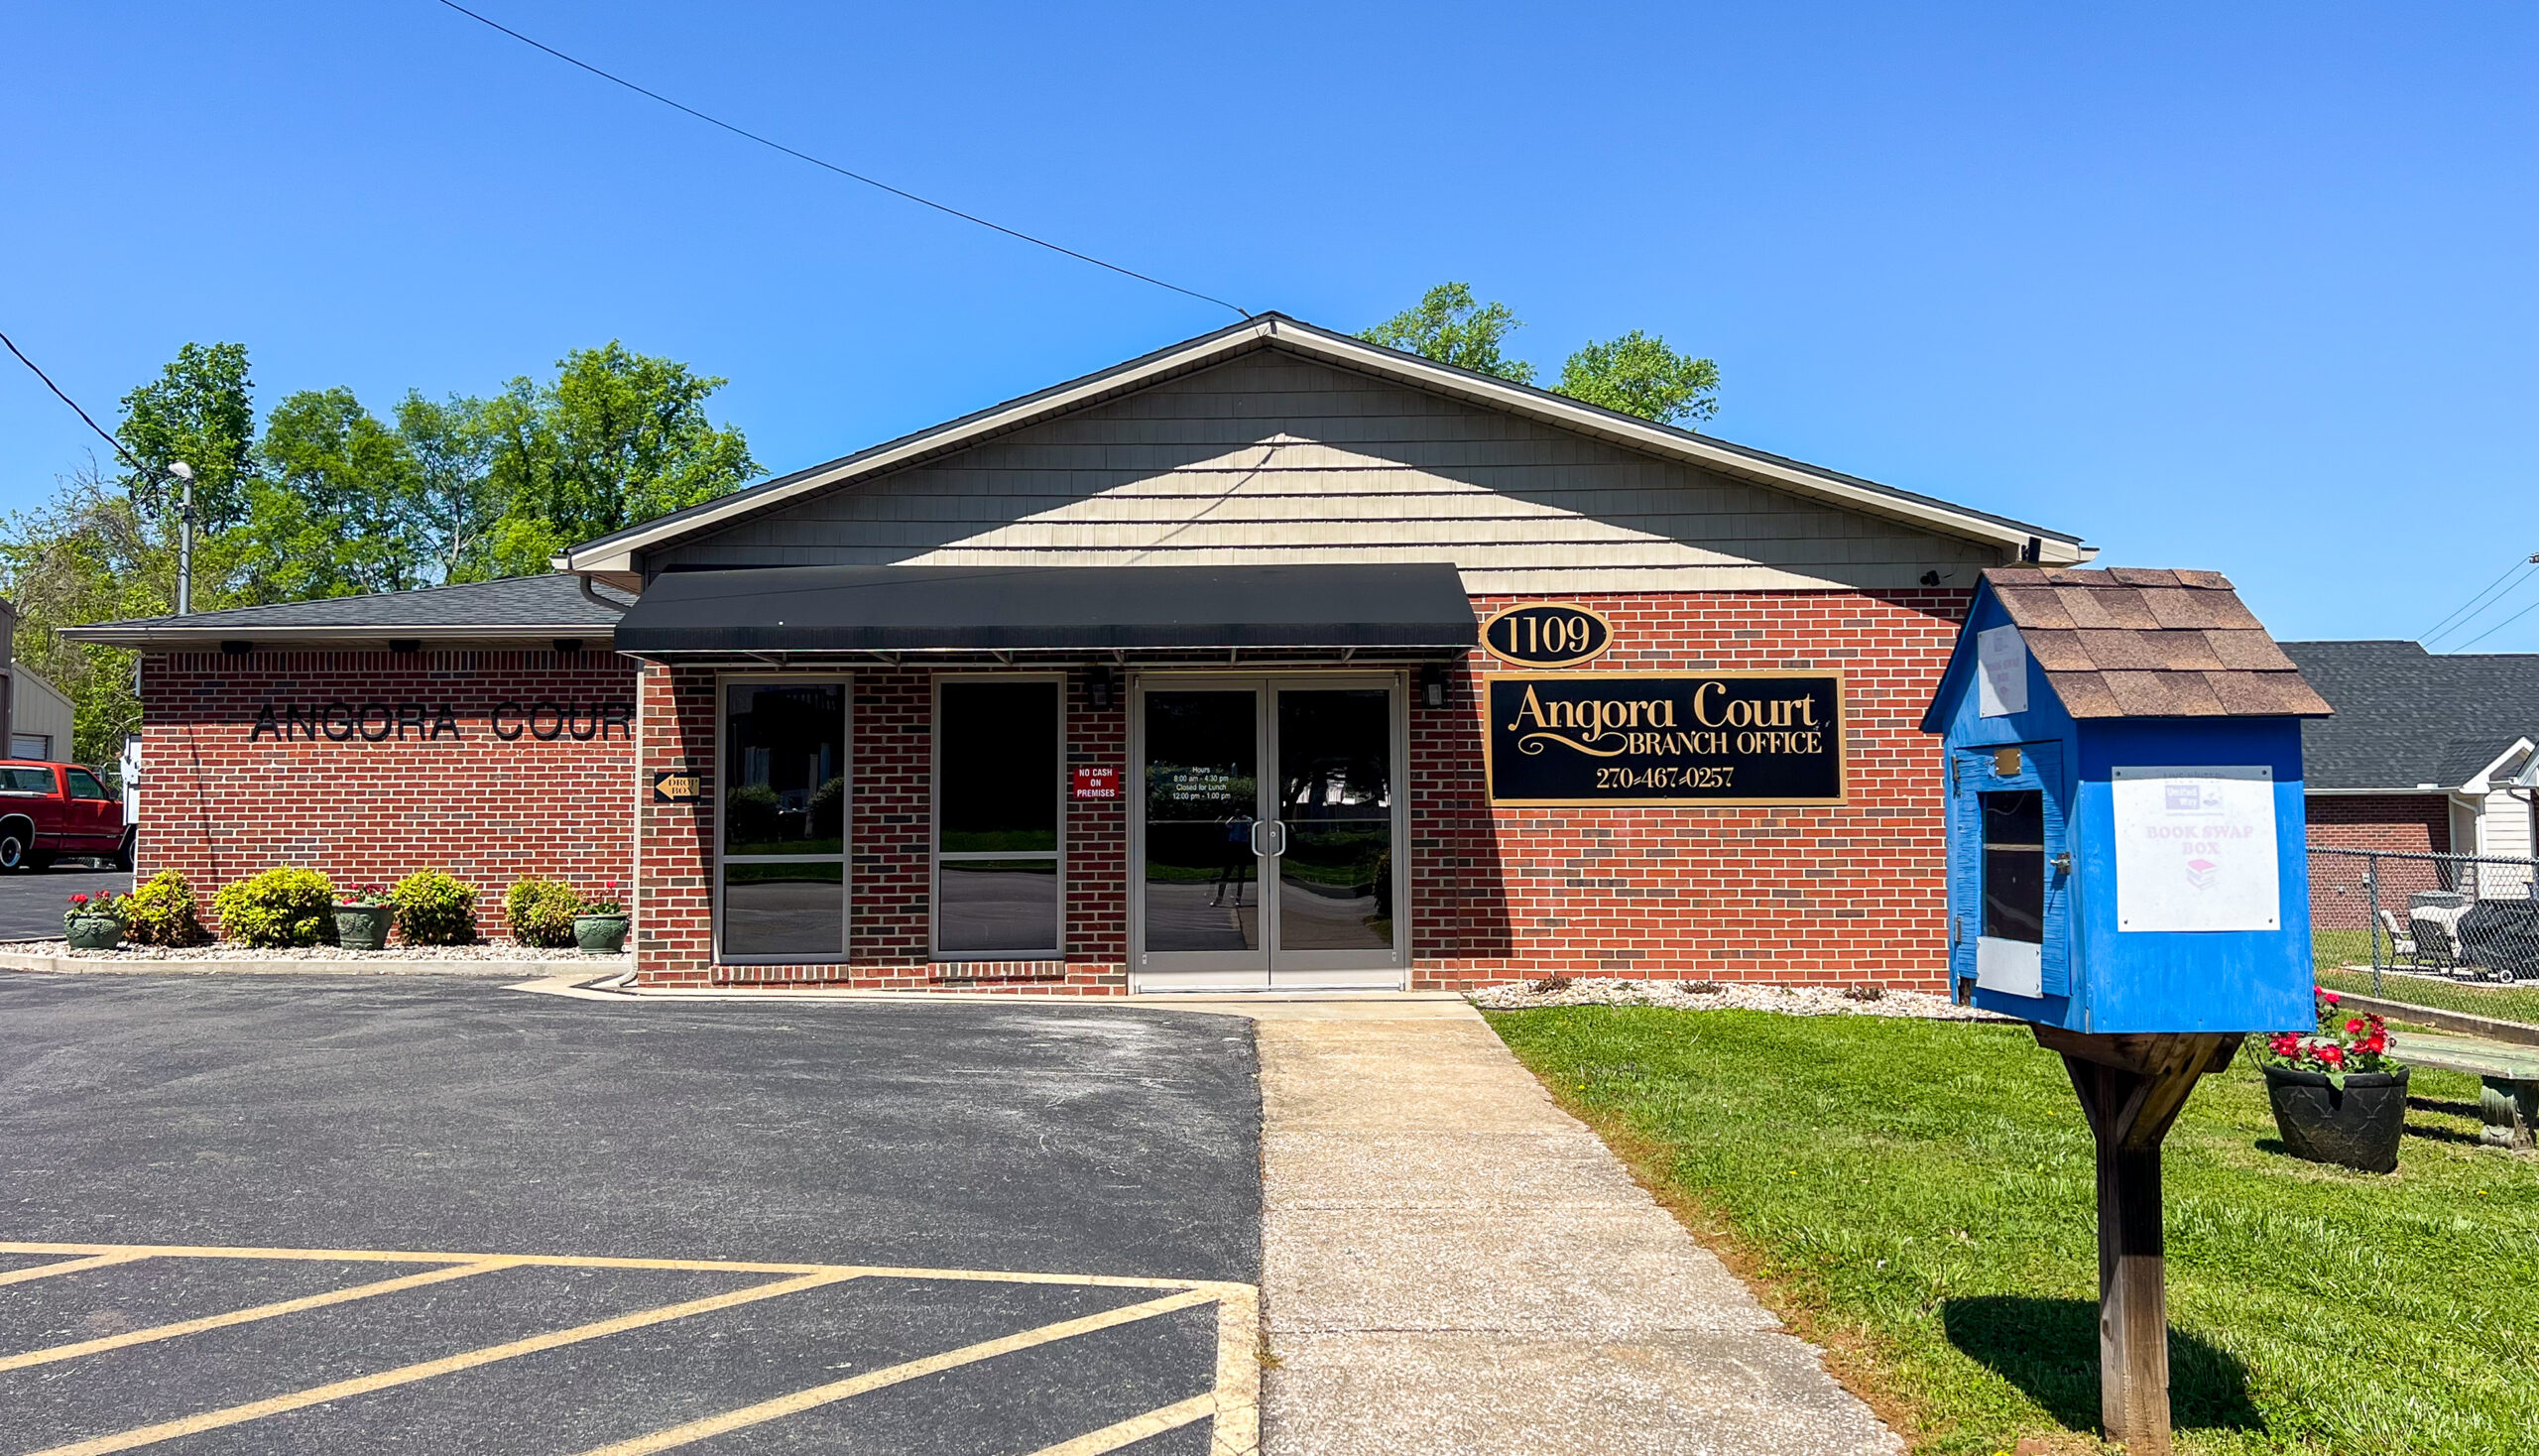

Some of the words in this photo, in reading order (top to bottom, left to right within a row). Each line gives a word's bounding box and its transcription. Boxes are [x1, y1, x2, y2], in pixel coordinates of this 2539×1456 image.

[1504, 616, 1590, 653] 1109
[252, 702, 461, 743] ANGORA
[1508, 683, 1677, 742] Angora
[1693, 681, 1818, 728] Court
[1629, 731, 1730, 757] BRANCH
[1737, 731, 1823, 755] OFFICE
[1596, 767, 1735, 789] 270-467-0257
[2146, 826, 2199, 839] BOOK
[2202, 825, 2254, 838] SWAP
[2182, 842, 2221, 855] BOX
